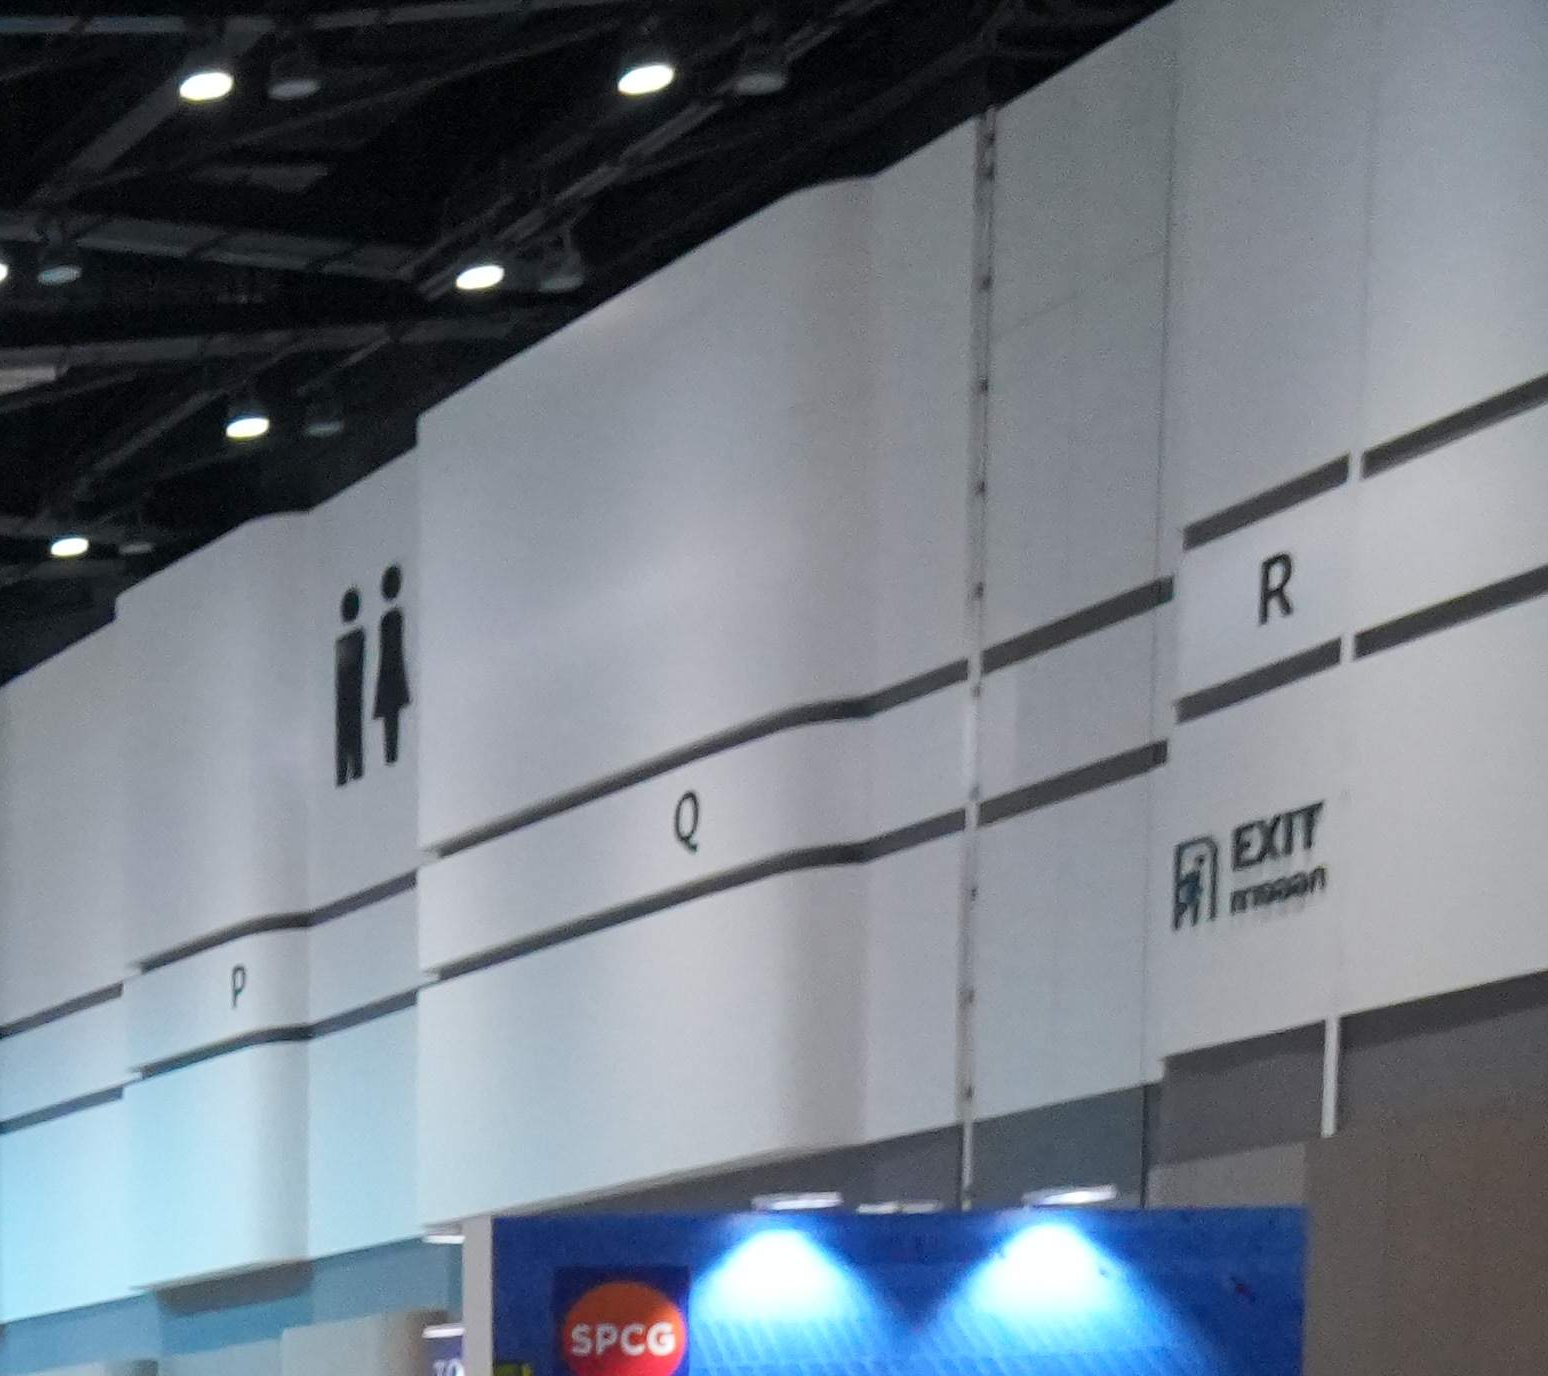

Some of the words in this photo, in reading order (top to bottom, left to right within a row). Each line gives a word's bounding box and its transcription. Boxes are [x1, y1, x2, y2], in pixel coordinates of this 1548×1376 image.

[1258, 553, 1294, 626] R
[674, 790, 701, 854] Q
[1231, 800, 1324, 871] EXIT
[231, 964, 247, 1008] P
[570, 1320, 678, 1358] SPCG
